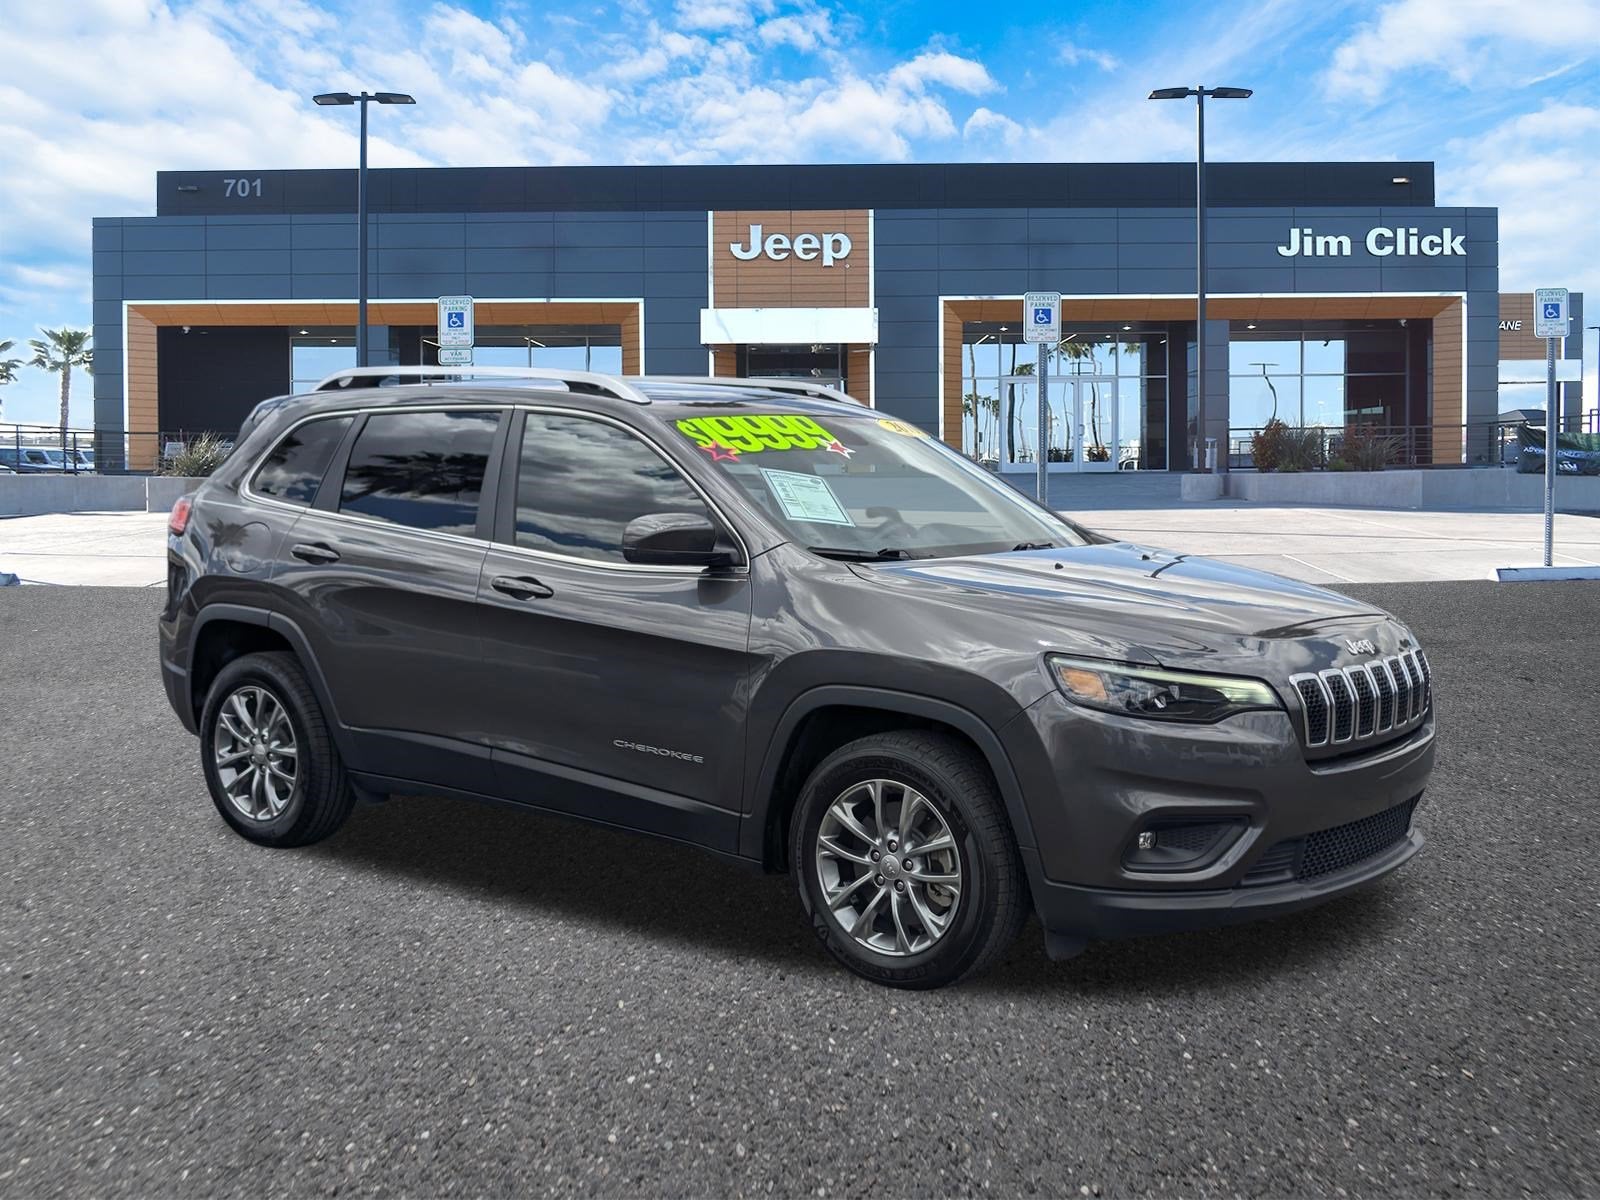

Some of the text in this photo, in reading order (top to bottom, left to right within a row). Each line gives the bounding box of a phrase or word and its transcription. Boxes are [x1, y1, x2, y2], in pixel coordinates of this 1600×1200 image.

[224, 178, 261, 197] 701
[730, 224, 852, 267] Jeep
[1277, 227, 1467, 257] Jim Click
[1345, 639, 1375, 654] Jeep
[613, 740, 704, 763] CHEROKEE
